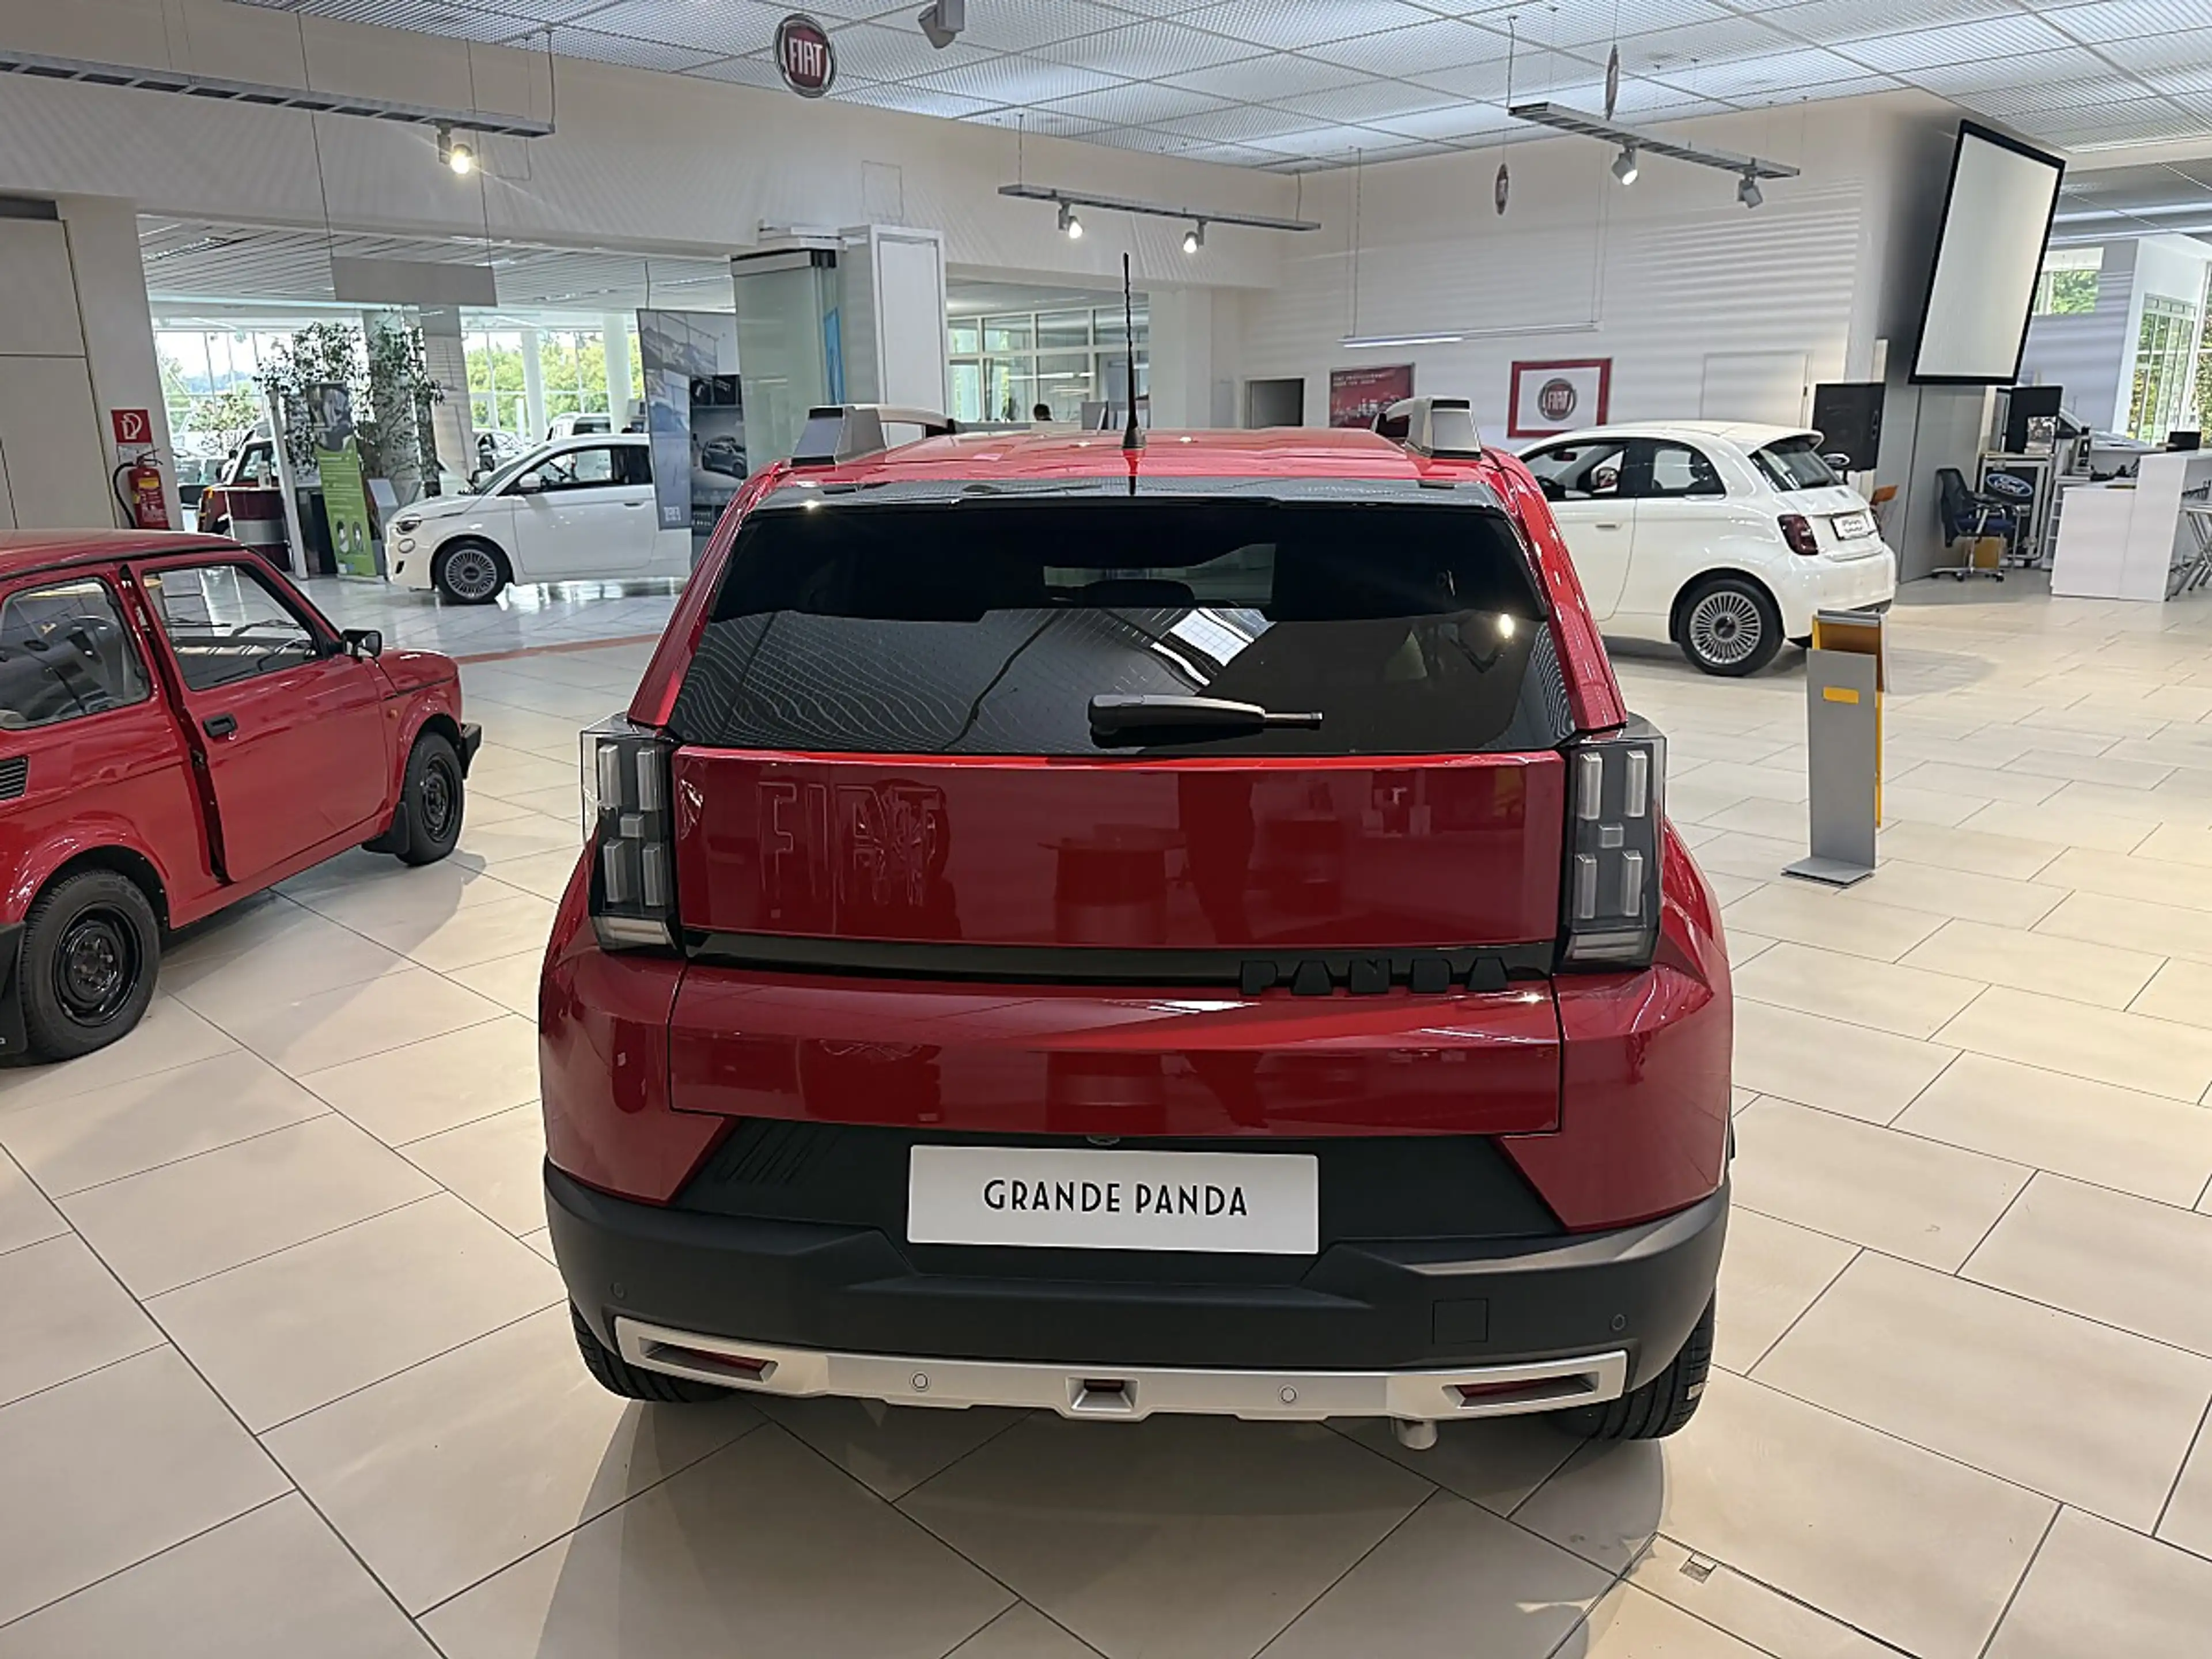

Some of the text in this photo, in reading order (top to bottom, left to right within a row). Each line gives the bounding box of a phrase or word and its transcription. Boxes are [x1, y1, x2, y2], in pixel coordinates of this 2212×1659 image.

[789, 36, 823, 78] FIAT
[1548, 391, 1569, 410] FIAT
[757, 781, 941, 906] FIAT
[1240, 956, 1509, 995] PANDA
[983, 1179, 1248, 1216] GRANDE PANDA
